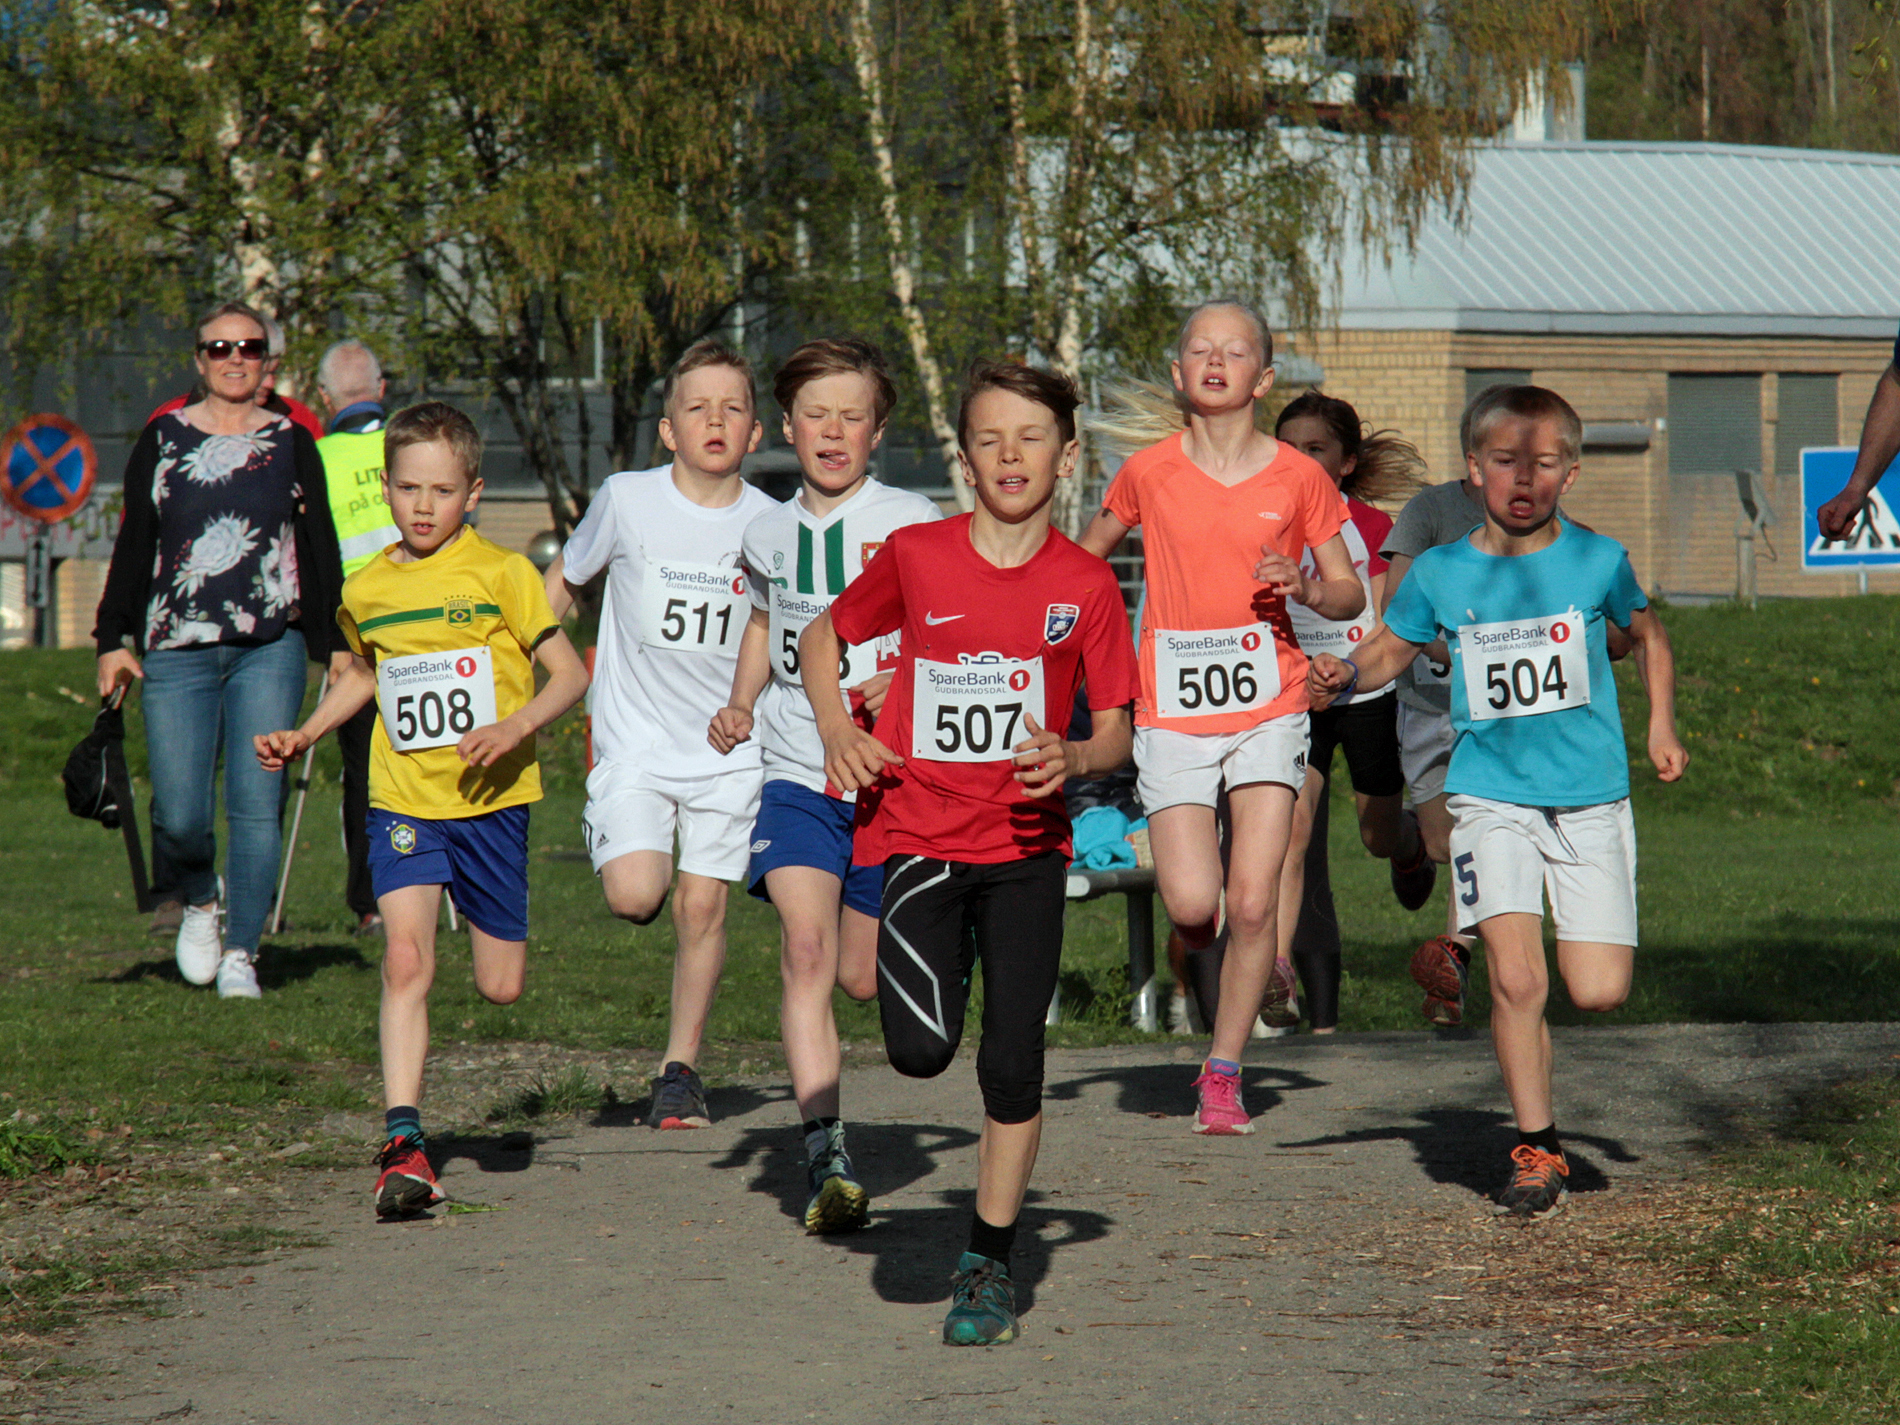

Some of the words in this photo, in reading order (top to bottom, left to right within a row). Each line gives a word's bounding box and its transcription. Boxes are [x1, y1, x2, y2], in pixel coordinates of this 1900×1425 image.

[355, 467, 383, 485] LIT
[659, 566, 731, 587] SpareBank
[665, 581, 729, 595] GUDBRANDSDAL
[661, 597, 732, 646] 511
[1167, 635, 1239, 652] SpareBank
[1473, 625, 1547, 646] SpareBank
[1175, 648, 1240, 658] GUDBRANDSDAL
[1482, 640, 1549, 653] GUDBRANDSDAL
[387, 659, 453, 679] SpareBank
[928, 669, 1006, 686] SpareBank
[393, 673, 455, 687] GUDBRANDSDAL
[935, 685, 1007, 695] GUDBRANDSDAL
[1178, 661, 1258, 709] 506
[1486, 654, 1568, 710] 504
[397, 687, 475, 742] 508
[935, 702, 1023, 754] 507
[1454, 851, 1480, 906] 5
